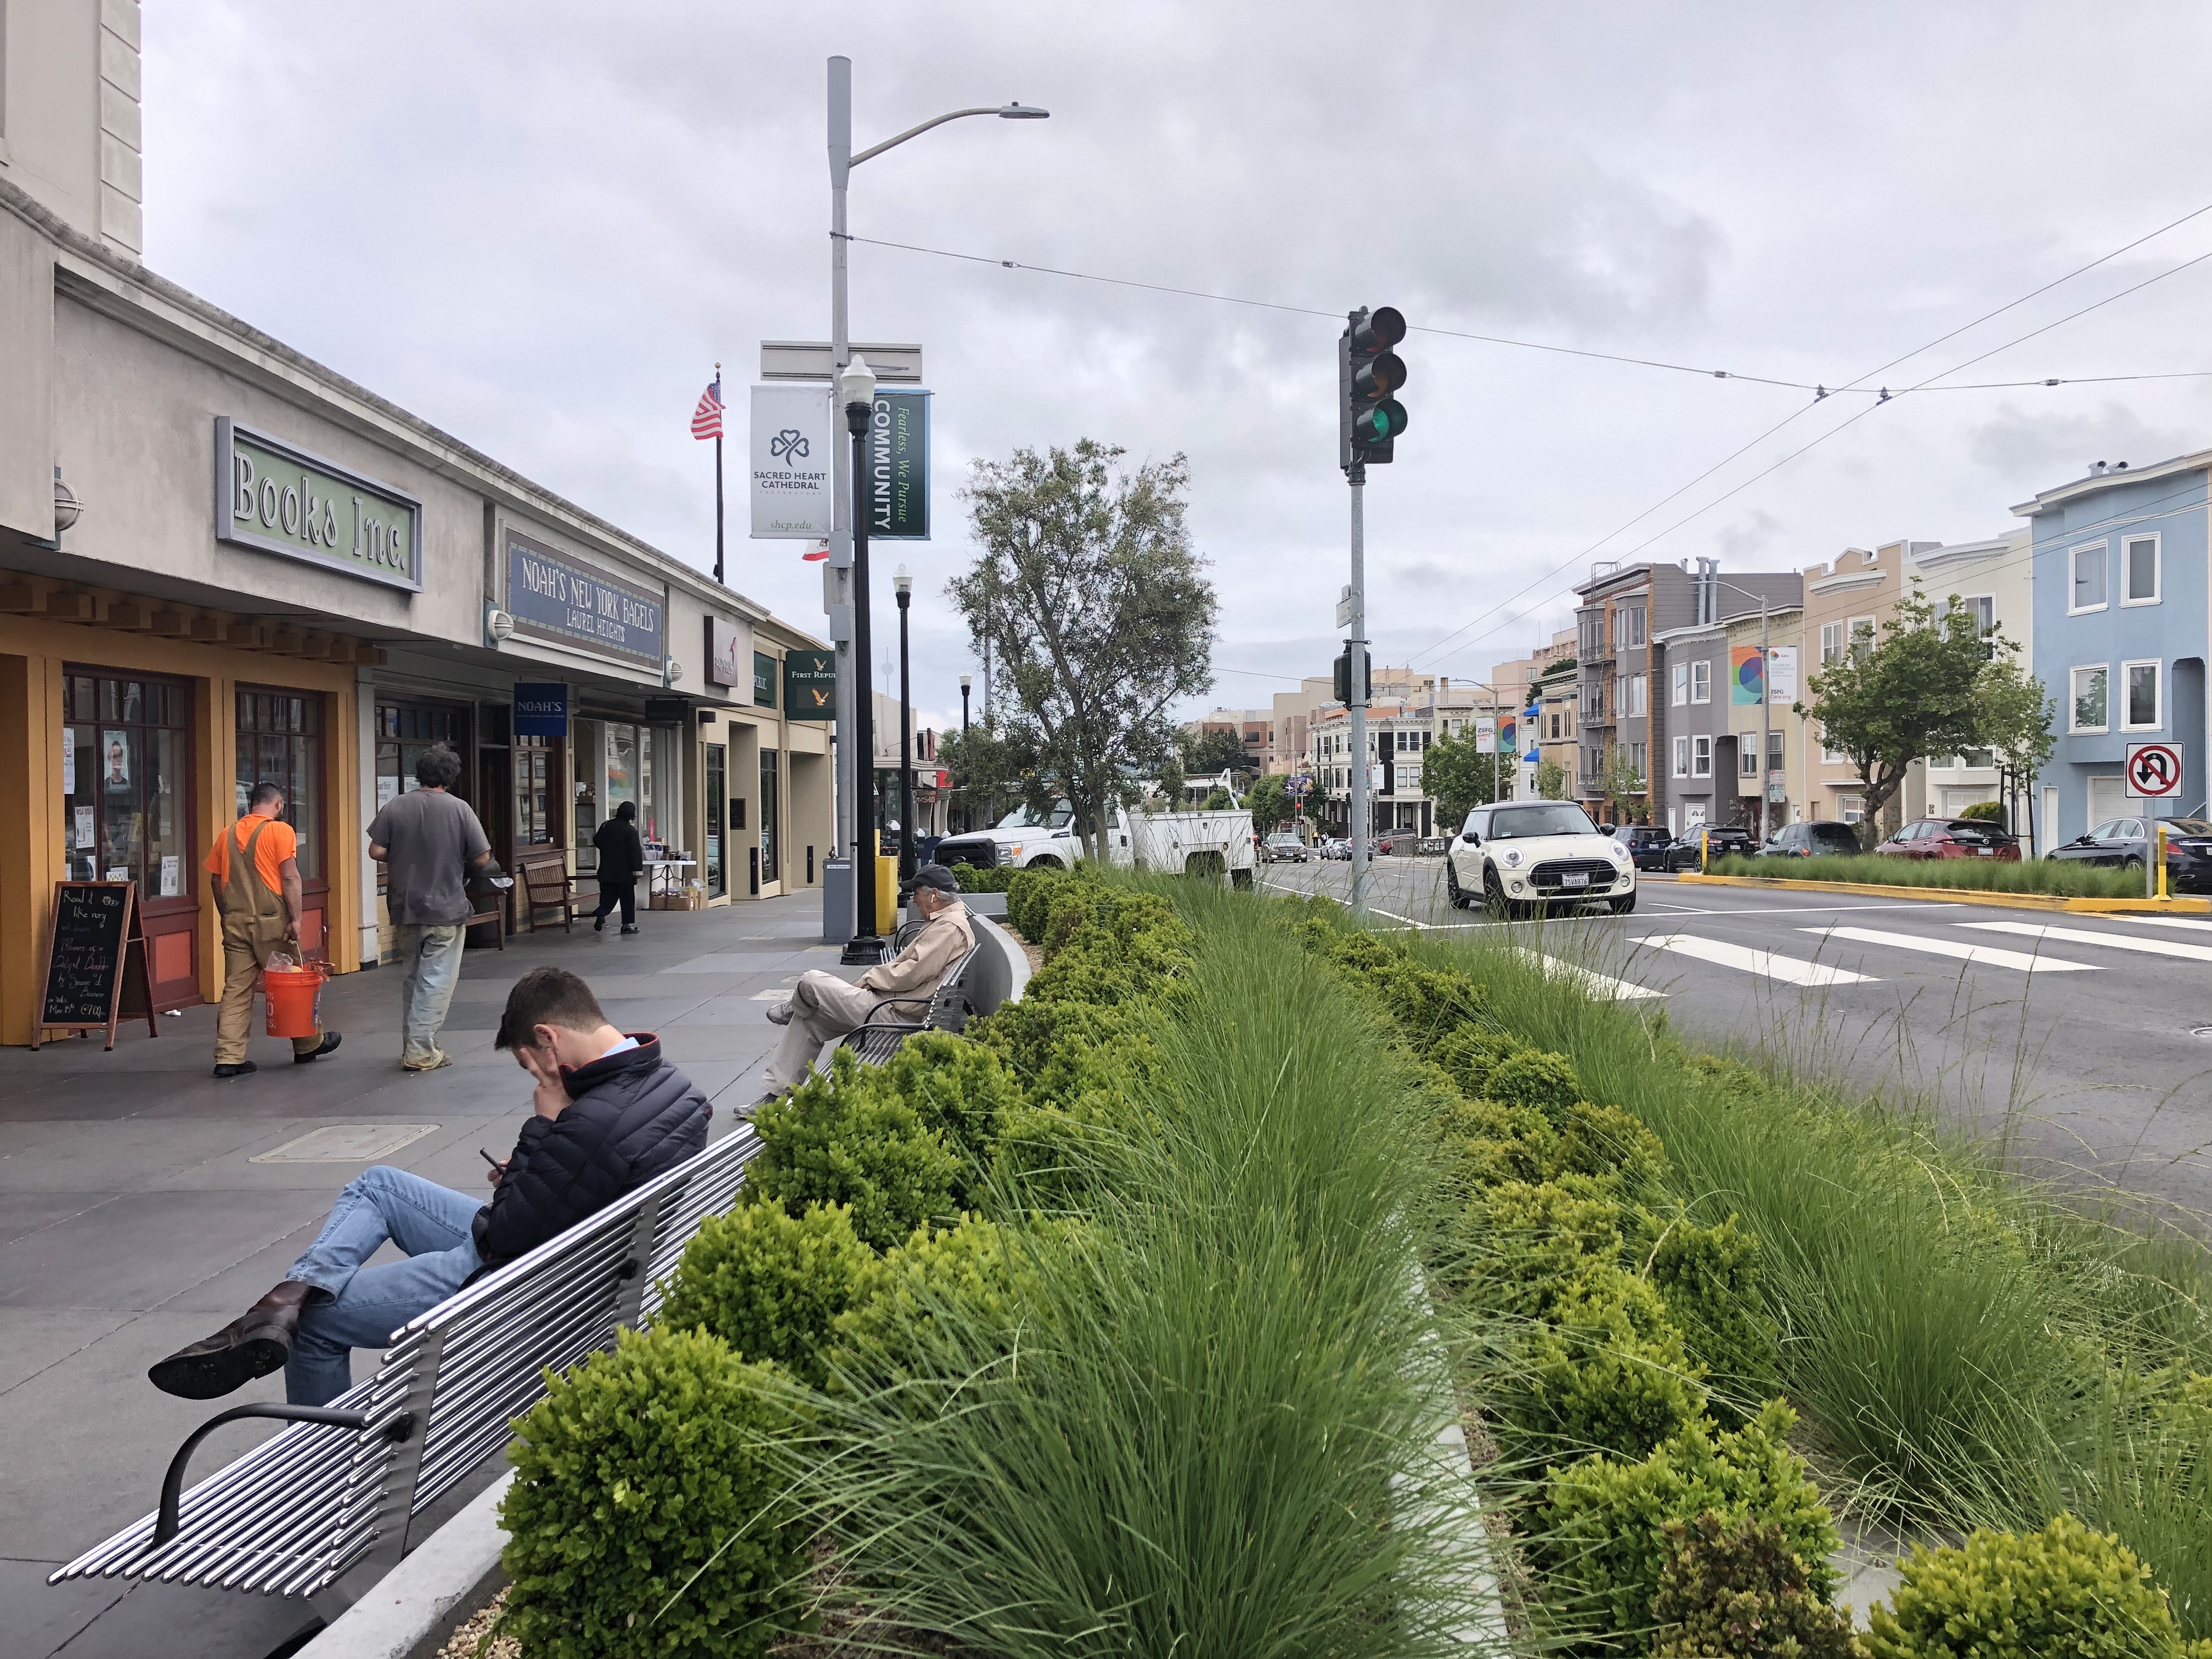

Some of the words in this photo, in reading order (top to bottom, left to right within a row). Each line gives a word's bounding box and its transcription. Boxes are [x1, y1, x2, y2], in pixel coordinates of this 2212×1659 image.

[896, 407, 911, 455] Fearless,
[874, 399, 891, 530] COMMUNITY
[898, 459, 910, 478] We
[754, 471, 792, 479] SACRED
[761, 481, 819, 489] CATHEDRAL
[234, 450, 339, 547] Books
[352, 496, 405, 570] Inc.
[898, 481, 910, 523] Pursue
[770, 520, 812, 531] shcp.edu
[522, 557, 566, 601] NOAH'S
[571, 577, 592, 610] NEW
[596, 586, 619, 620] YORK
[623, 598, 654, 633] BAGELS
[566, 608, 595, 633] LAUREL
[597, 617, 626, 643] HEIGHTS
[754, 675, 767, 690] PUBLIC
[518, 701, 562, 712] NOAH'S
[63, 889, 85, 903] Read
